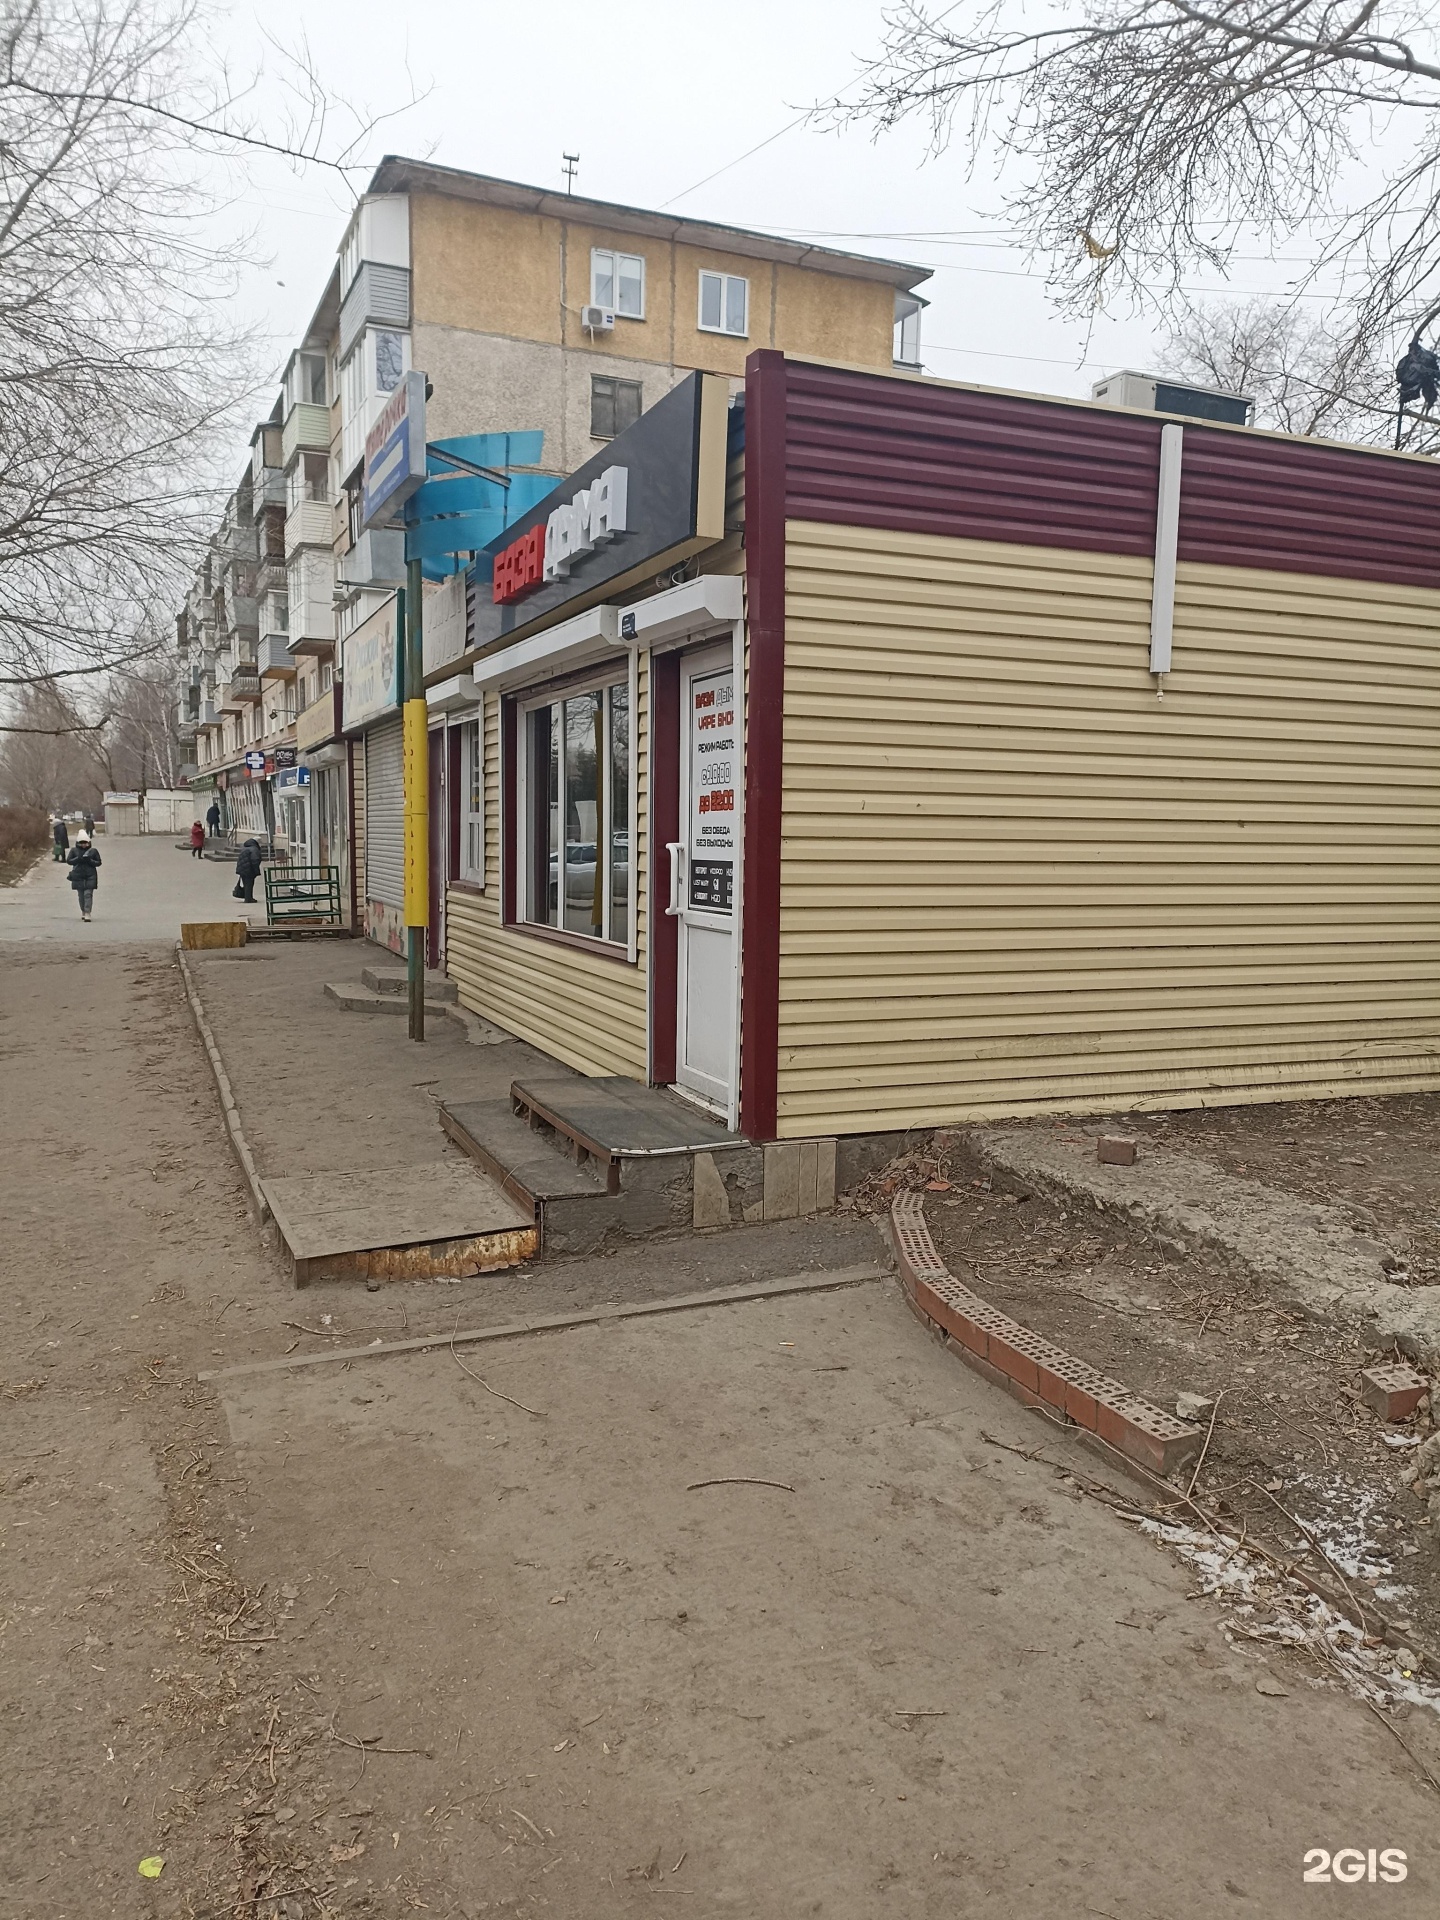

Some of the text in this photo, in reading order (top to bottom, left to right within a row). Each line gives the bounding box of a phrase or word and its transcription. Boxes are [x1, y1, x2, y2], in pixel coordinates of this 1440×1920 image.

[493, 465, 628, 605] БАЗА ДЫМА
[698, 713, 716, 730] VAPE
[698, 742, 716, 753] РЕЖИМ
[702, 826, 731, 835] БЕЗ ОБЕДА
[696, 839, 733, 848] БЕЗ ВЫХОДНЫ
